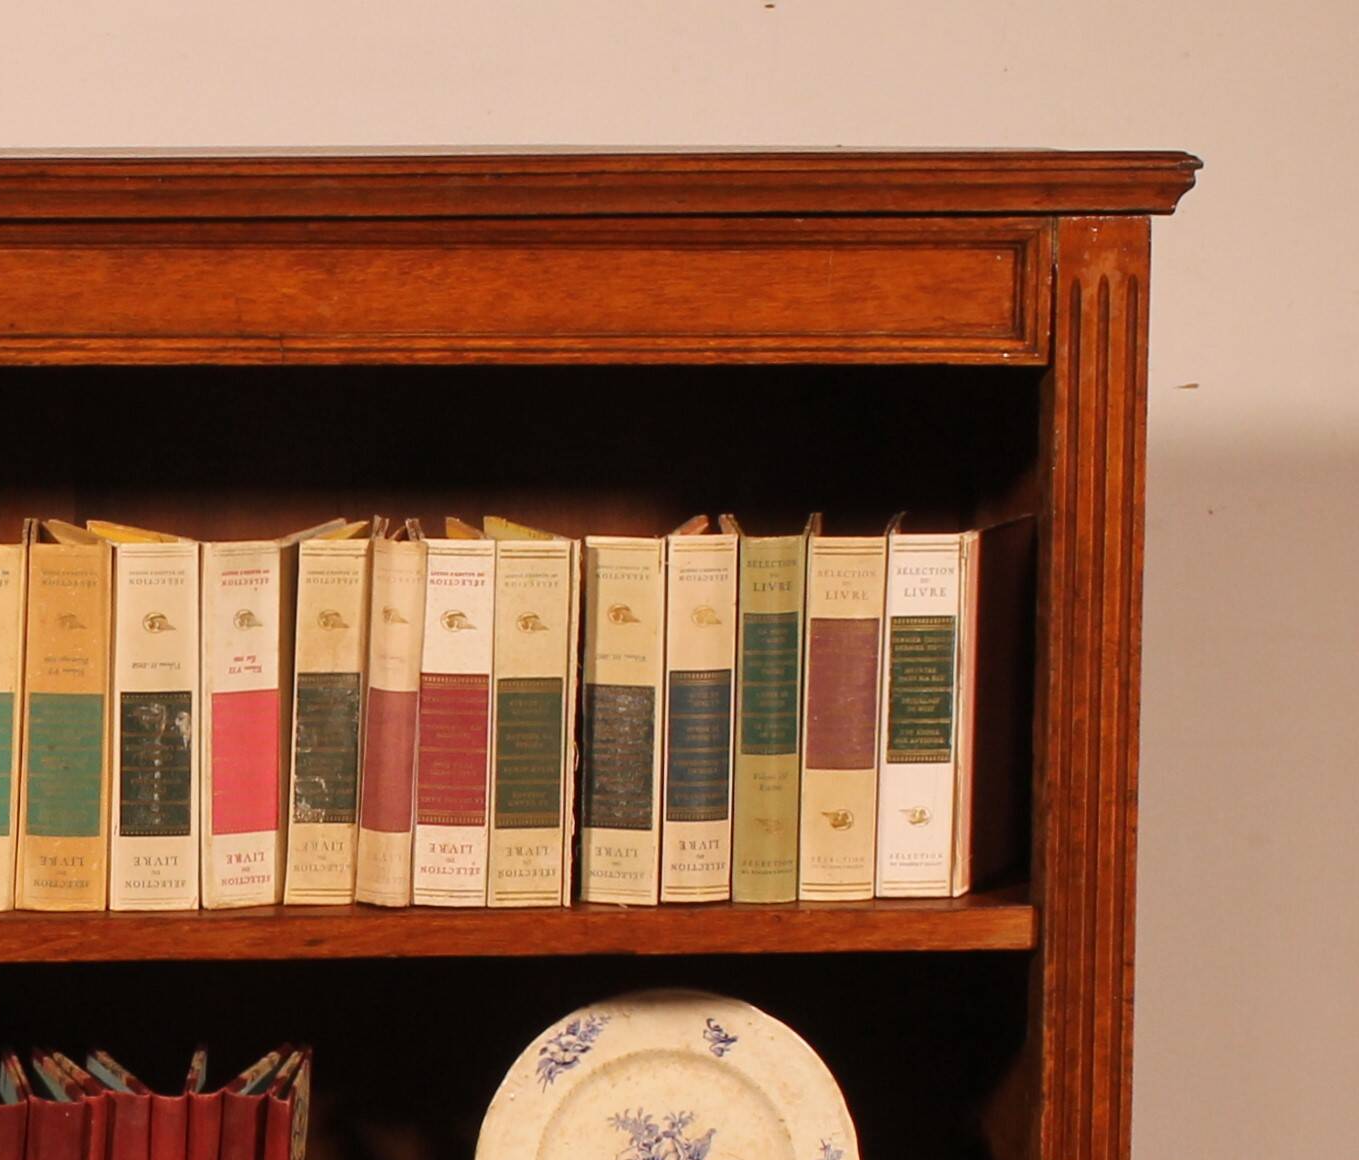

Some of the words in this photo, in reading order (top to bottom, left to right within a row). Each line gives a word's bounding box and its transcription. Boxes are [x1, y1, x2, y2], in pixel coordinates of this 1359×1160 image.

[752, 581, 792, 593] LIVRE
[903, 587, 947, 598] LIVRE
[825, 590, 870, 601] LIVRE
[429, 843, 474, 855] LIVRE
[678, 840, 719, 851] LIVRE
[505, 846, 550, 857] LIVRE
[595, 846, 638, 858] LIVRE
[39, 856, 85, 867] LIVRE
[132, 855, 178, 867] LIVRE
[226, 852, 265, 865] LIVRE
